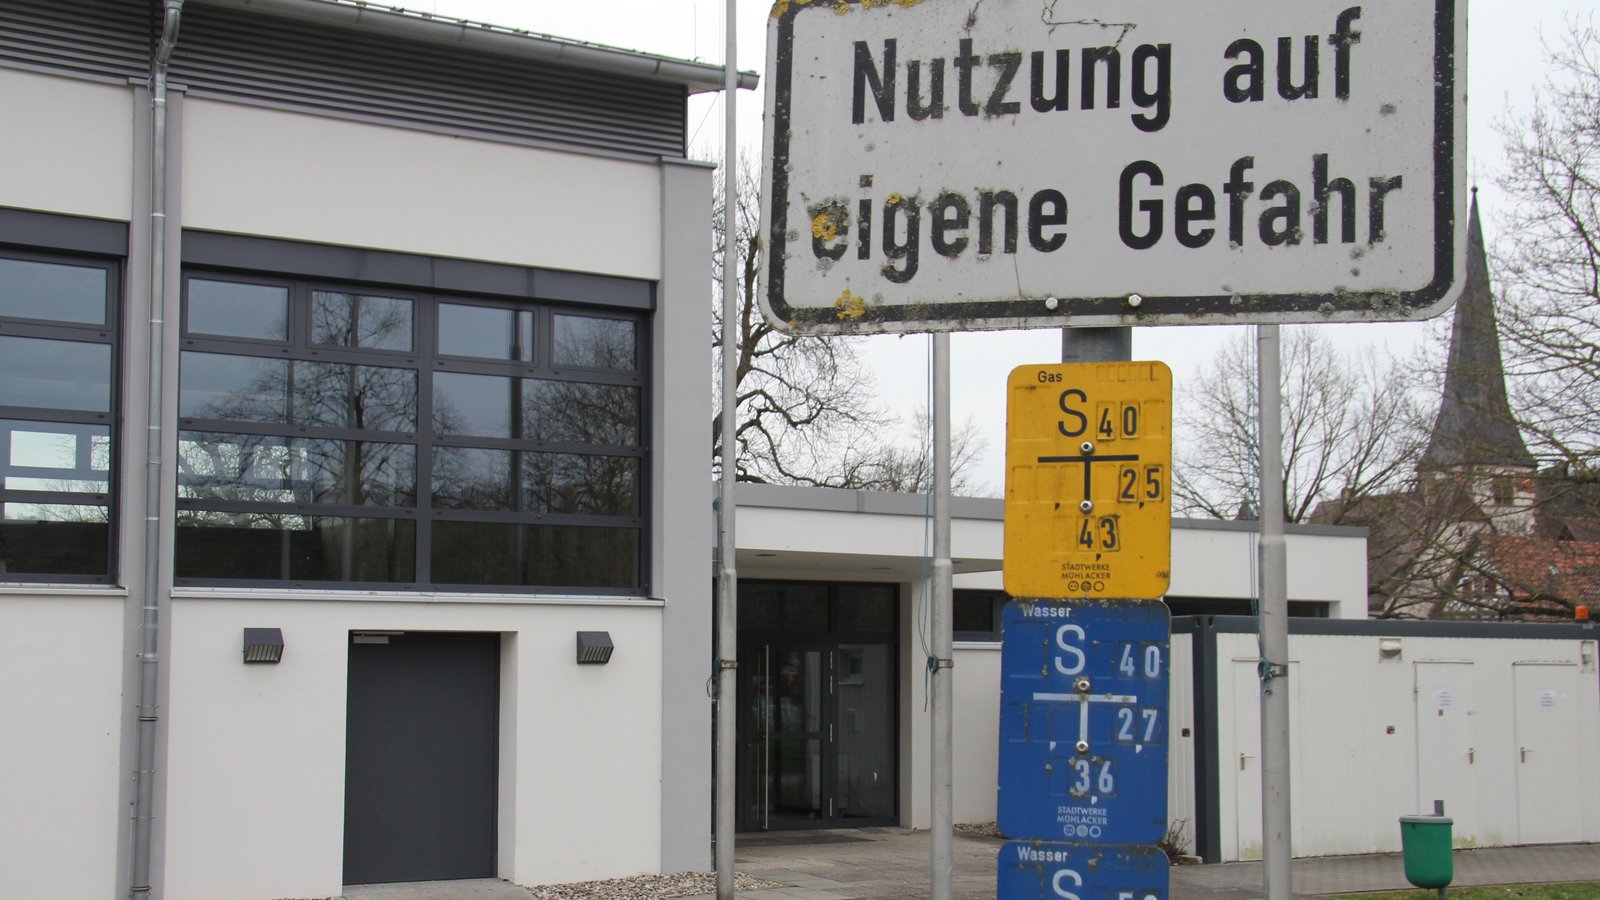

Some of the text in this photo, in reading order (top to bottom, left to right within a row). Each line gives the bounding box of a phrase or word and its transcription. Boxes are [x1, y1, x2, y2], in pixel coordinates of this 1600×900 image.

[852, 6, 1361, 132] Nutzung auf
[811, 153, 1403, 284] eigene Gefahr
[1037, 370, 1063, 383] Gas
[1058, 388, 1138, 438] S 40
[1061, 563, 1110, 571] STADTWERKE
[1022, 605, 1072, 618] Wasser
[1055, 624, 1161, 678] S 40
[1057, 806, 1108, 816] STADTWERKE
[1017, 846, 1069, 862] Wasser
